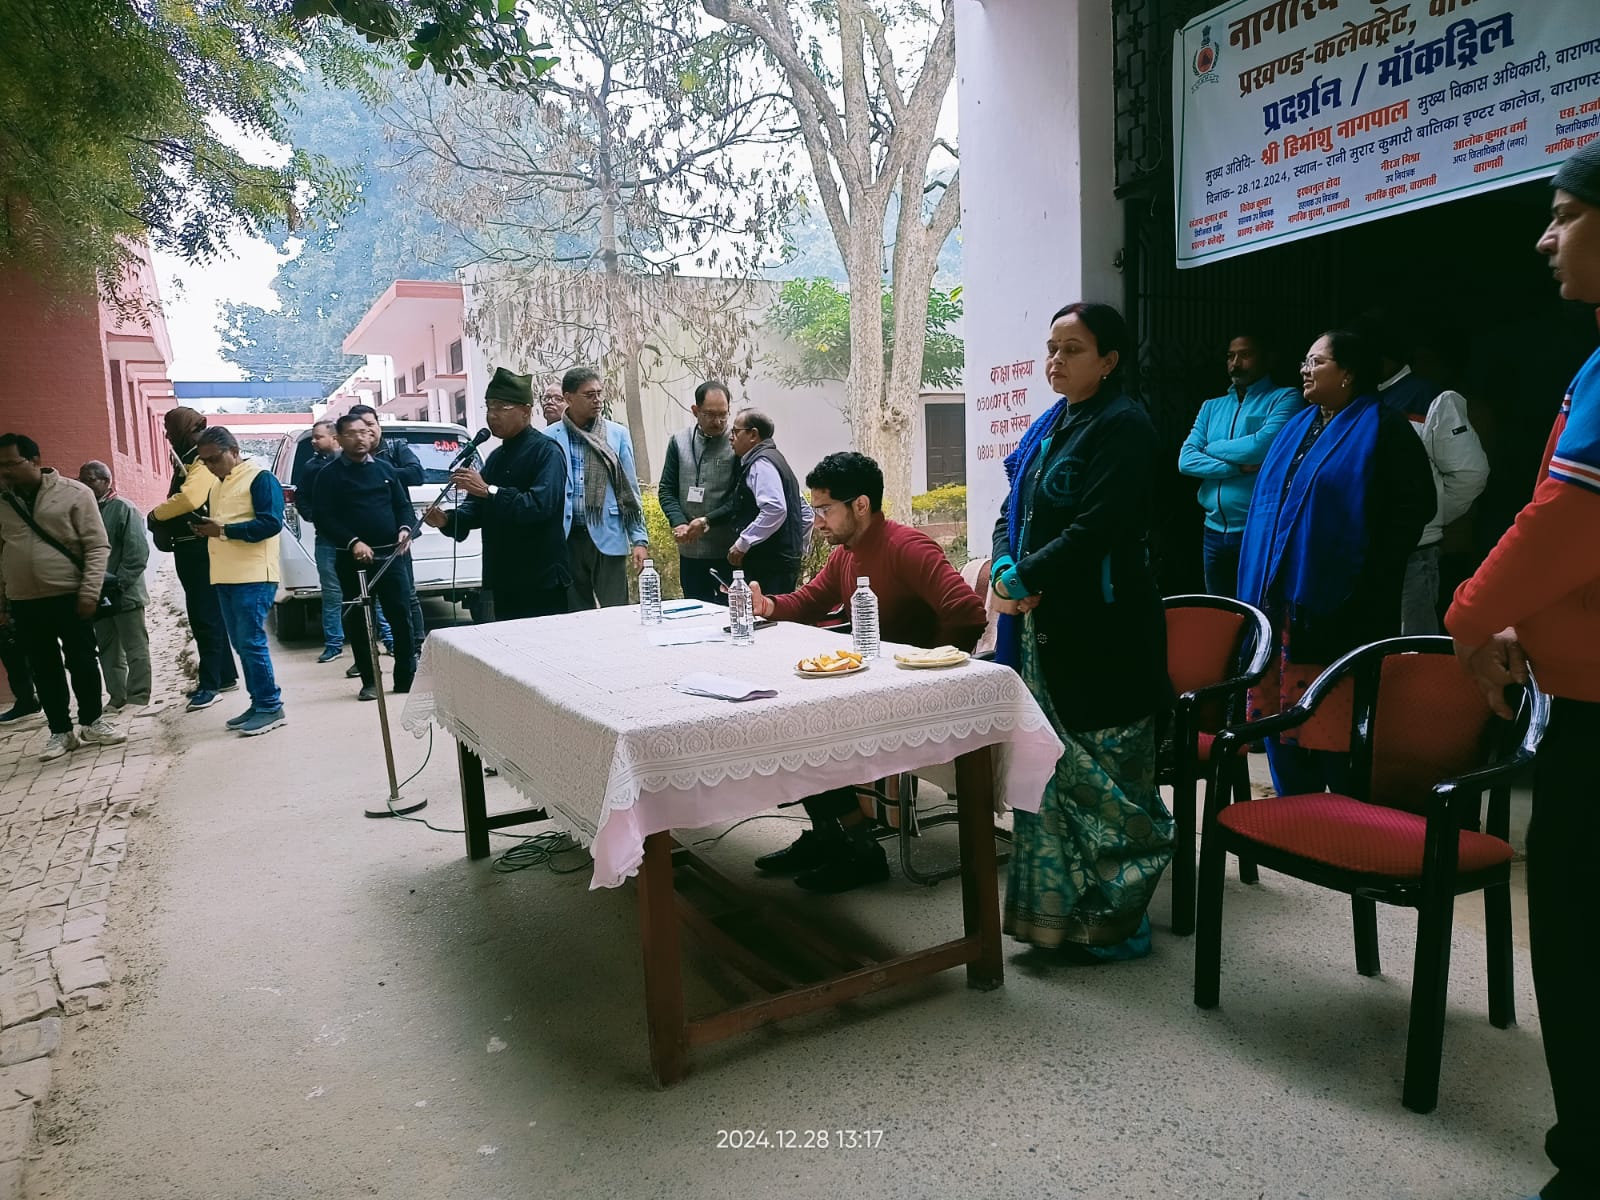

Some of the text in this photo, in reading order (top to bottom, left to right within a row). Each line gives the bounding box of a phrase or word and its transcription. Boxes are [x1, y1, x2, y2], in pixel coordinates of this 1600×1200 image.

[1263, 12, 1514, 135] प्रदर्शन / मॉकड्रिल
[1205, 166, 1223, 186] मुख्य
[1261, 141, 1280, 165] श्री
[1283, 127, 1333, 159] हिमांशु
[1337, 98, 1410, 139] नागपाल
[1418, 89, 1446, 115] मुख्य
[1450, 75, 1489, 101] विकास
[1492, 50, 1551, 86] अधिकारी,
[1556, 113, 1600, 136] जिलाधिकारी/
[1237, 172, 1290, 195] 28.12.2024,
[1326, 148, 1346, 167] रानी
[1350, 141, 1374, 163] मुरार
[1378, 127, 1412, 154] कुमारी
[1416, 115, 1459, 138] बालिका
[1463, 104, 1495, 127] इण्टर
[1499, 89, 1545, 112] कालेज,
[1453, 116, 1528, 150] आलोक कुमार वर्मा
[1380, 152, 1420, 171] नीरज मिश्रा
[1453, 153, 1467, 164] अपर
[1469, 139, 1505, 160] जिलाधिकारी
[1473, 155, 1504, 173] वाराणसी
[1365, 188, 1387, 202] नागरिक
[1409, 173, 1437, 190] वाराणसी
[990, 360, 1035, 385] कक्षा संख्या
[1012, 388, 1027, 407] तल
[990, 413, 1031, 438] कक्षा संख्या
